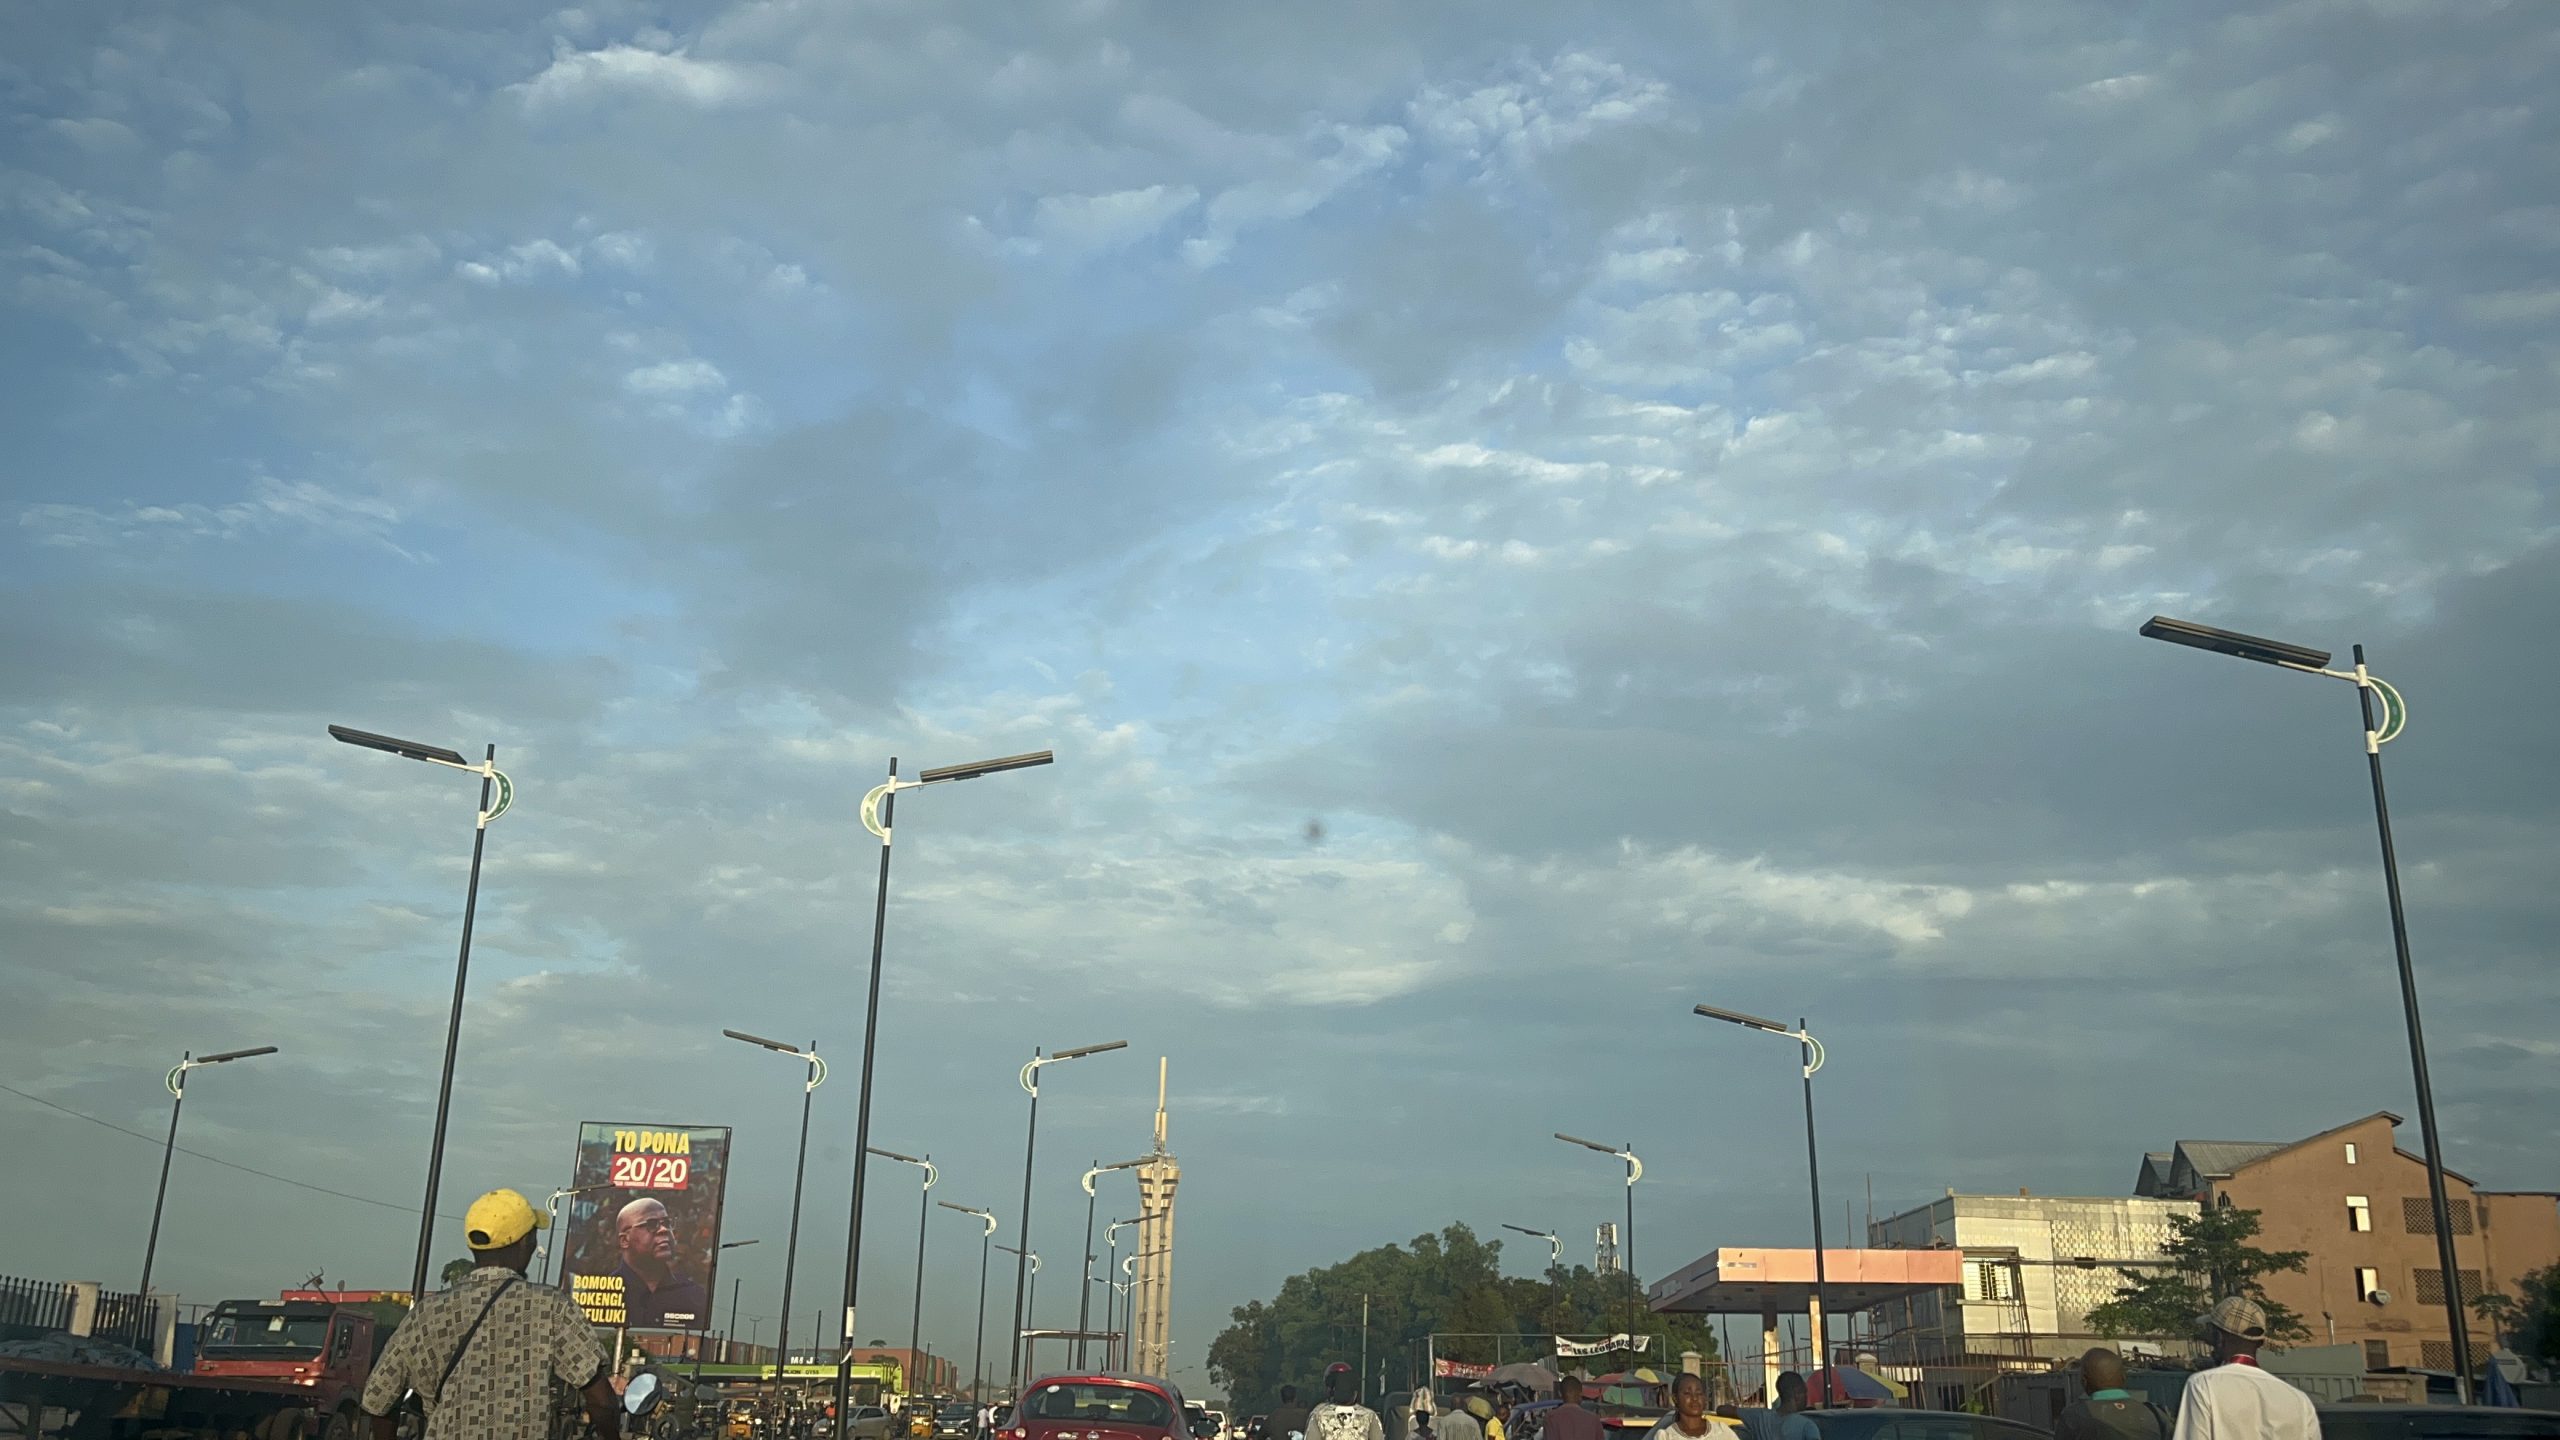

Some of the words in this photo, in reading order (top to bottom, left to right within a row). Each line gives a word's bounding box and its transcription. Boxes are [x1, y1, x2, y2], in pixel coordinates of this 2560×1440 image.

[614, 1130, 637, 1153] TO
[639, 1130, 690, 1155] PONA
[613, 1156, 688, 1187] 20/20
[572, 1274, 626, 1293] BOMOKO,
